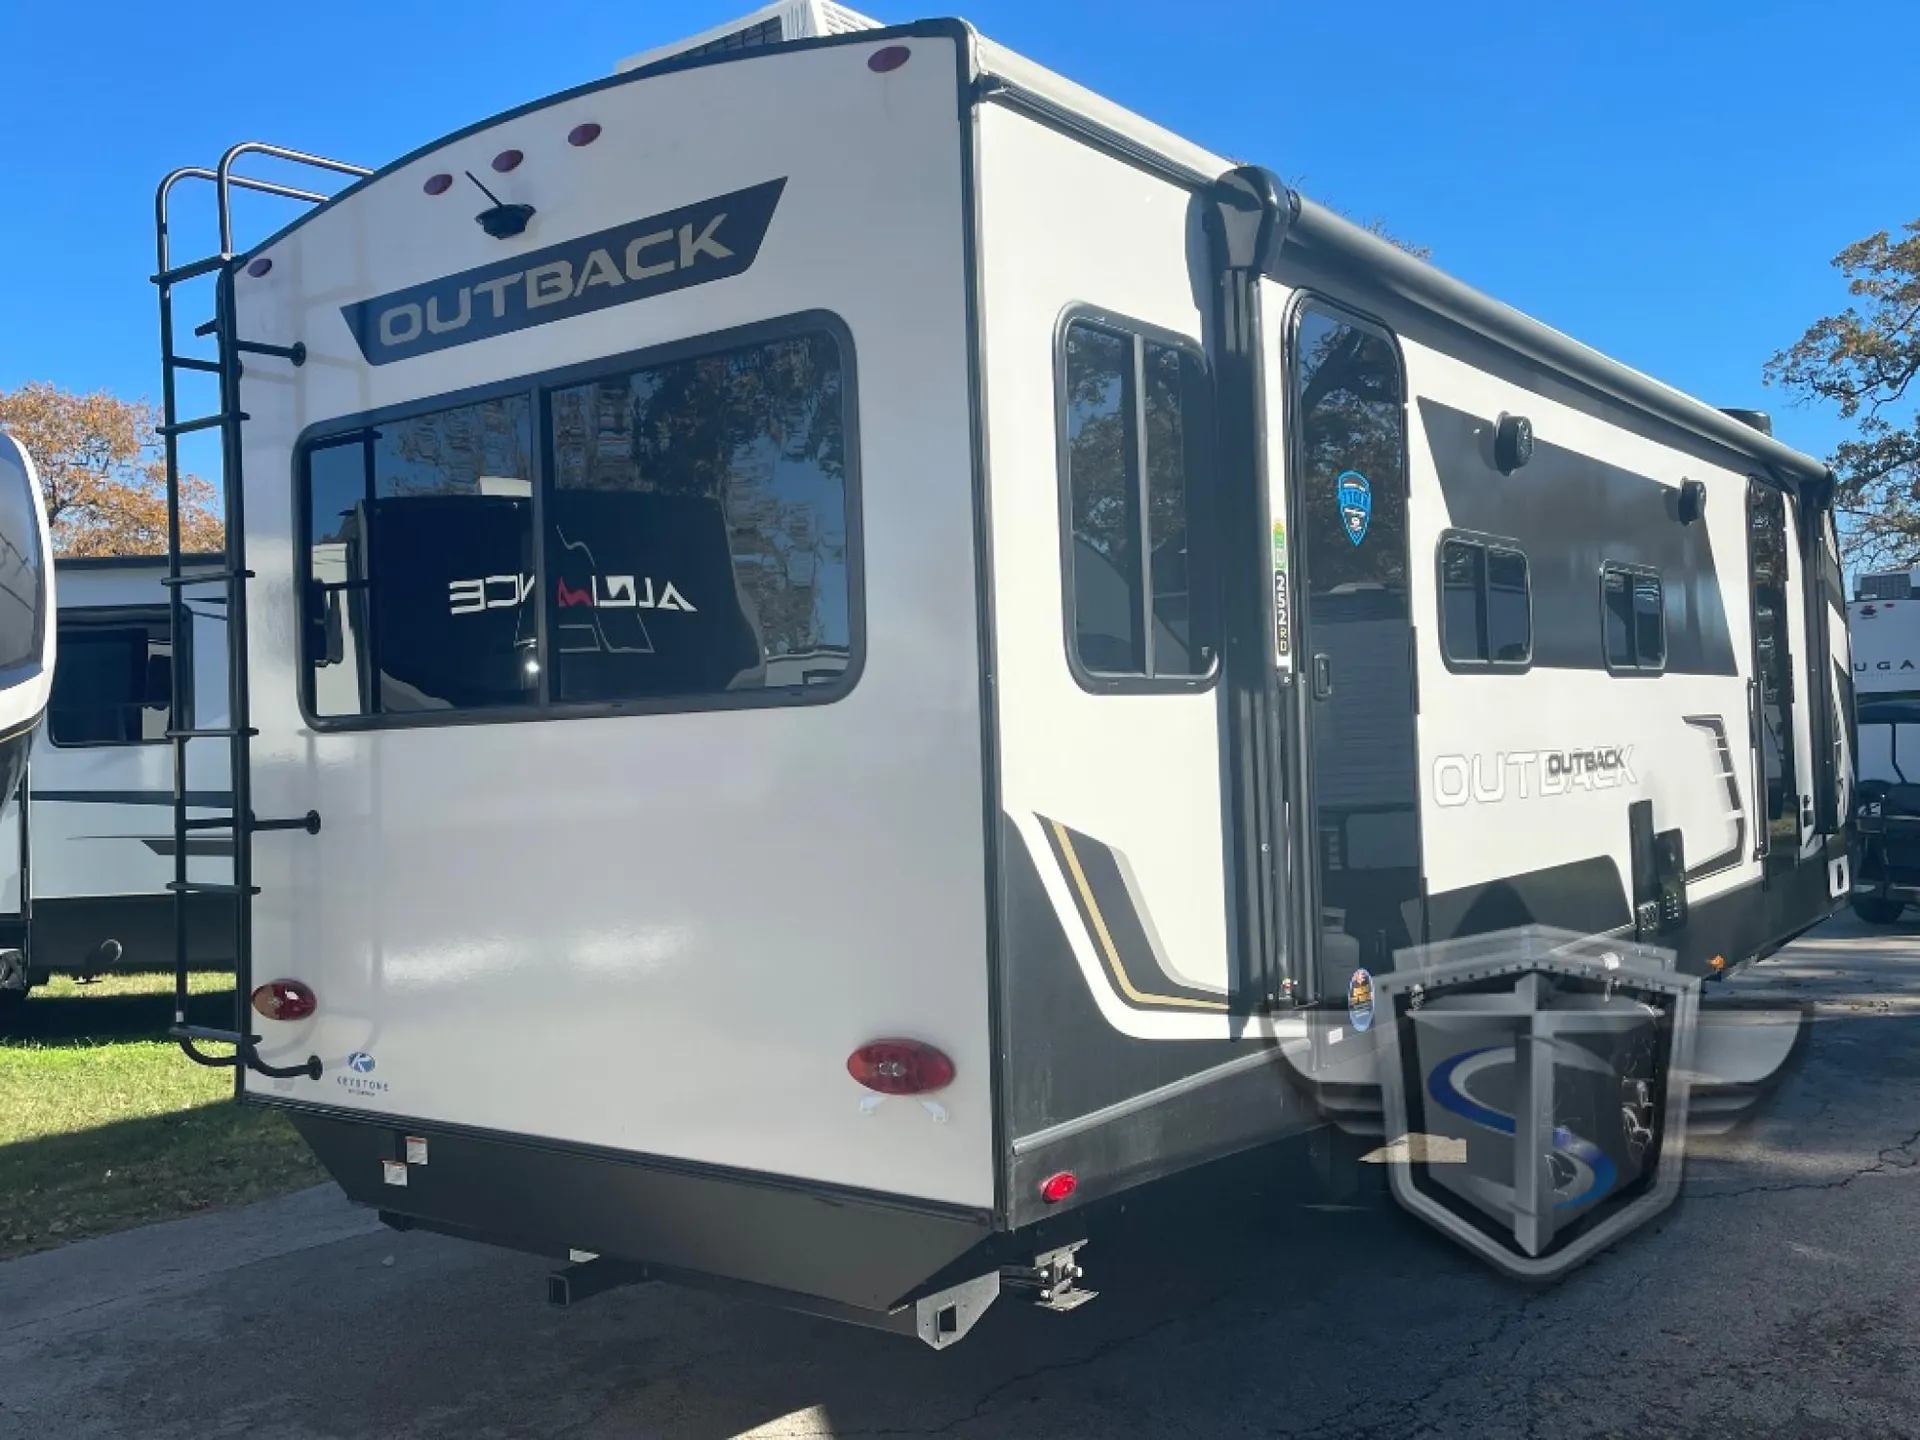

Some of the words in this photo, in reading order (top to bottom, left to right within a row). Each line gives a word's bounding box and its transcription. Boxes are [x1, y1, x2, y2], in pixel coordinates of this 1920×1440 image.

[379, 213, 735, 346] OUTBACK
[1433, 744, 1638, 807] OUTBACK
[1549, 750, 1625, 775] OUTBACK
